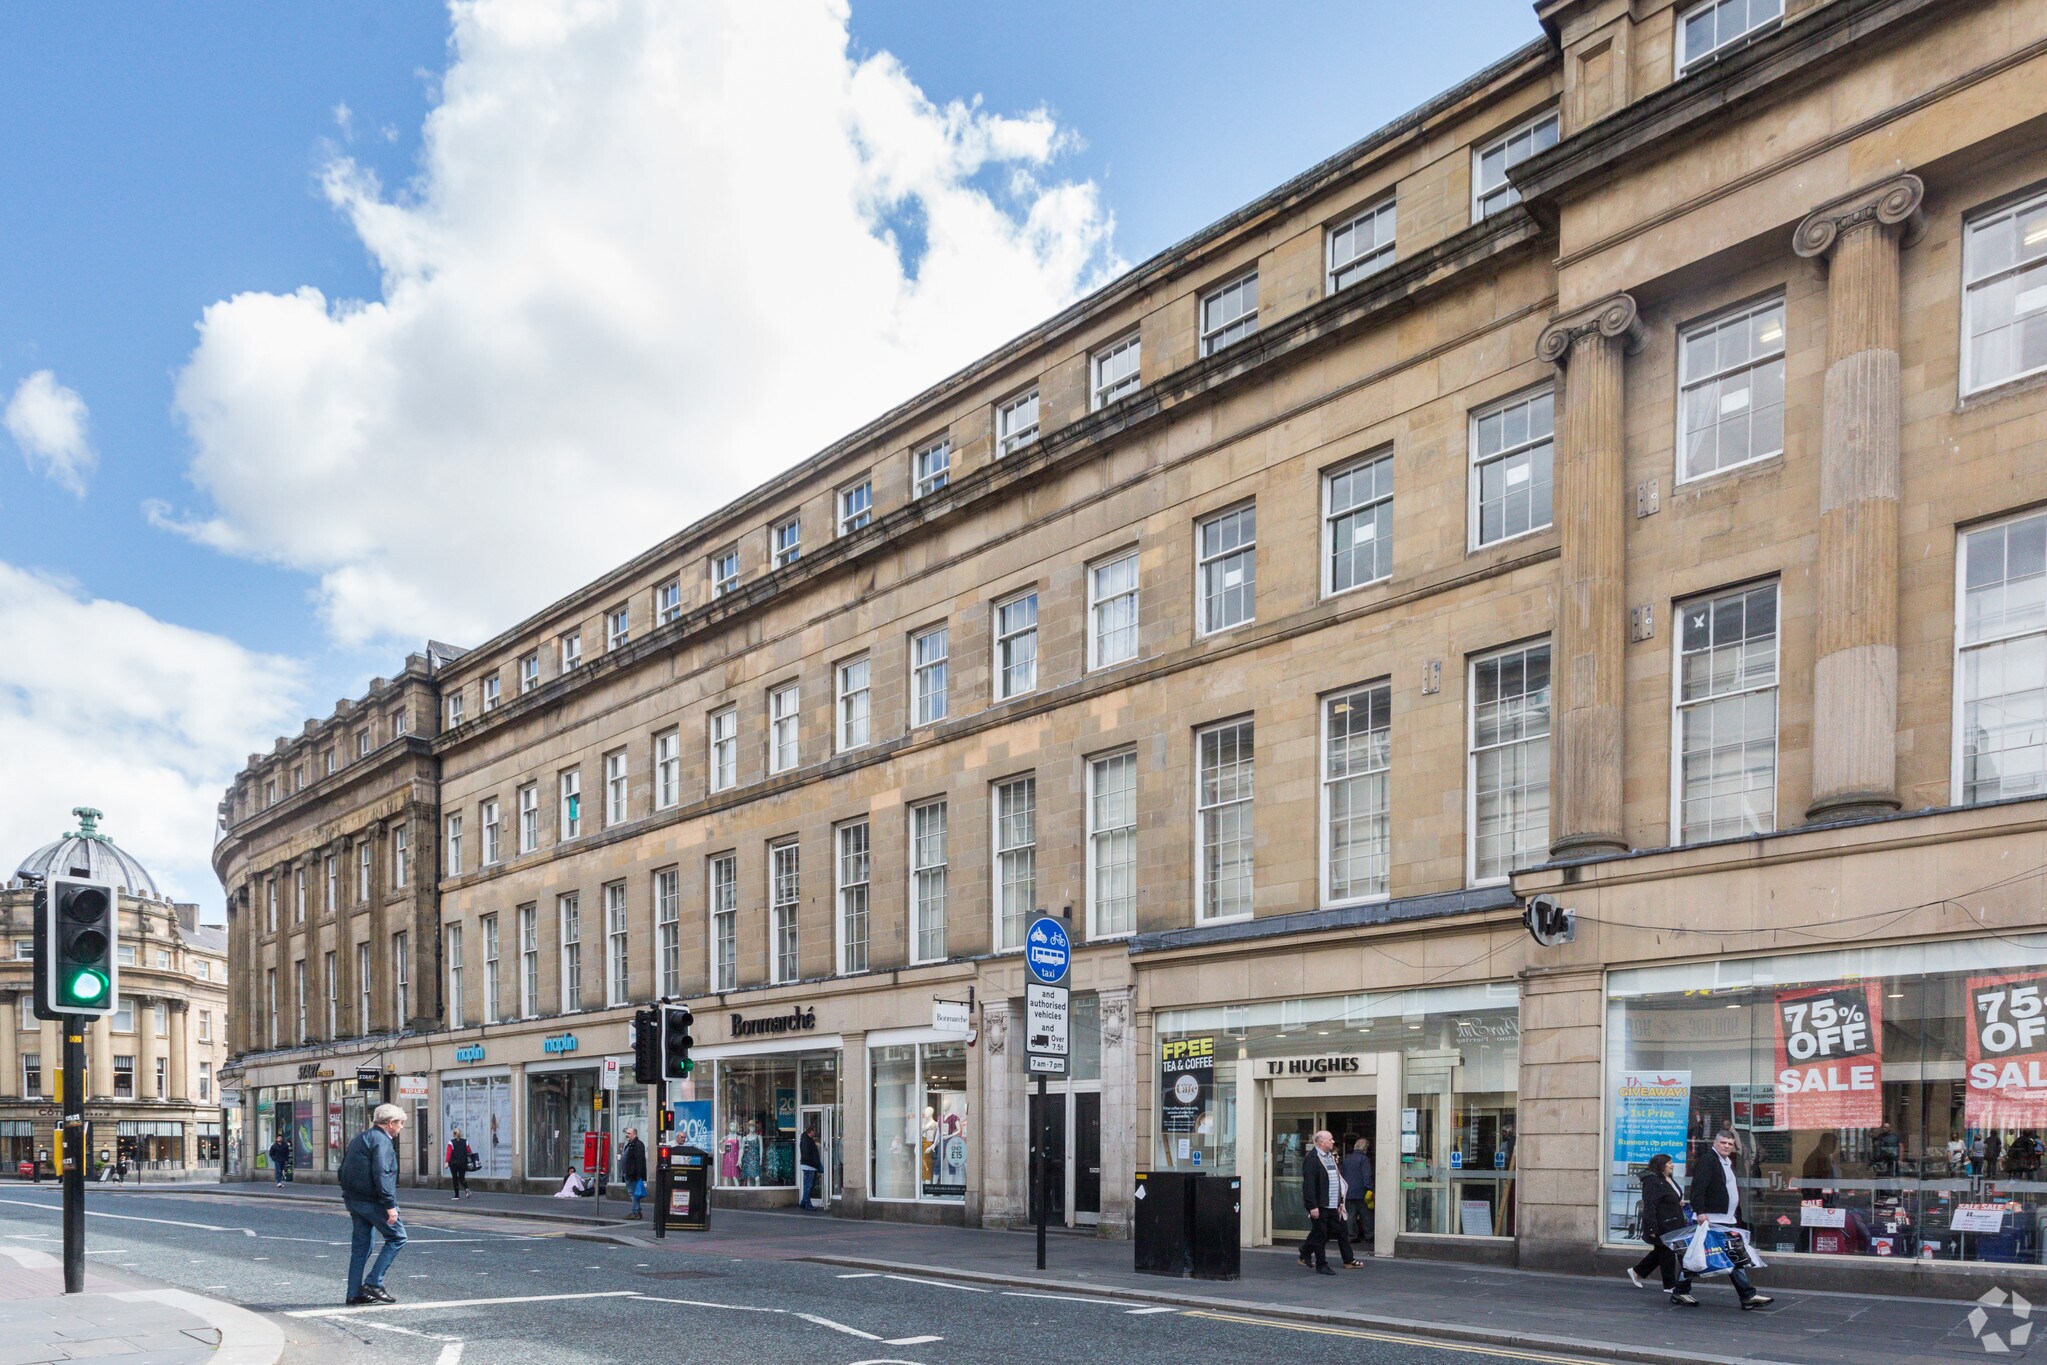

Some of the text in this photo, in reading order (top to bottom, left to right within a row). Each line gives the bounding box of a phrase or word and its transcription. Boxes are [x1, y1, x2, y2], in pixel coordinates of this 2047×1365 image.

[1041, 968, 1055, 978] taxi
[1041, 991, 1055, 999] and
[1030, 1000, 1066, 1010] authorised
[729, 1005, 816, 1037] Bonmarché
[1034, 1010, 1062, 1020] vehicles
[1041, 1024, 1055, 1032] and
[1981, 1016, 2046, 1052] OF
[543, 1033, 578, 1055] maplin
[1051, 1043, 1064, 1051] 7.5t
[1787, 1022, 1866, 1060] OFF
[455, 1043, 485, 1064] maplin
[297, 1063, 320, 1080] START
[1163, 1056, 1213, 1072] TEA & COFFEE
[1266, 1057, 1360, 1075] TJ HUGHES
[1779, 1066, 1875, 1094] SALE
[1969, 1061, 2047, 1090] SAL
[779, 1097, 795, 1111] 20
[1631, 1109, 1675, 1118] 1st Prize
[678, 1119, 708, 1142] 20%
[951, 1151, 963, 1160] £15
[1801, 1200, 1822, 1208] SALE
